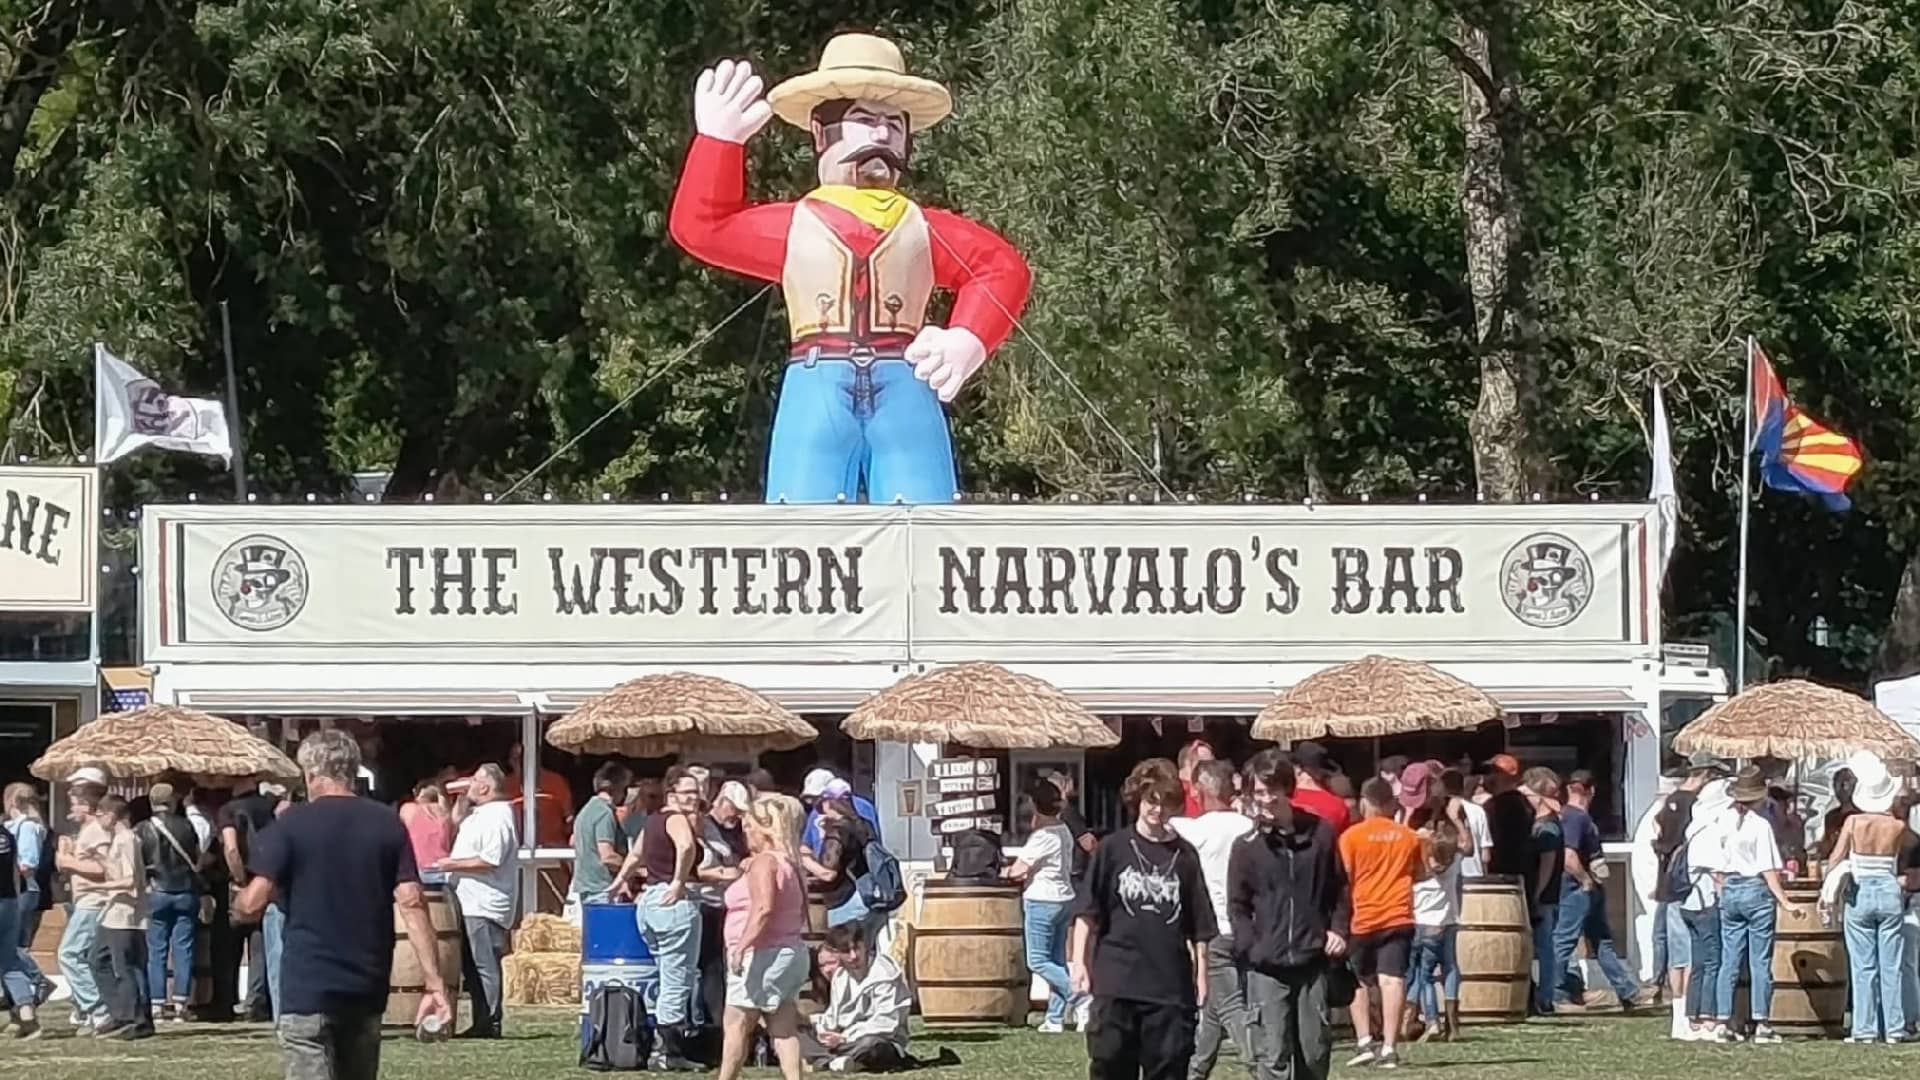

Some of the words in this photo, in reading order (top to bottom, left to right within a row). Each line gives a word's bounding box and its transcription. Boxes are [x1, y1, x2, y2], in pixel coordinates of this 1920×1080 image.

[386, 547, 517, 615] THE
[548, 547, 863, 615] WESTERN
[938, 535, 1299, 615] NARVALO'S
[1331, 547, 1465, 615] BAR
